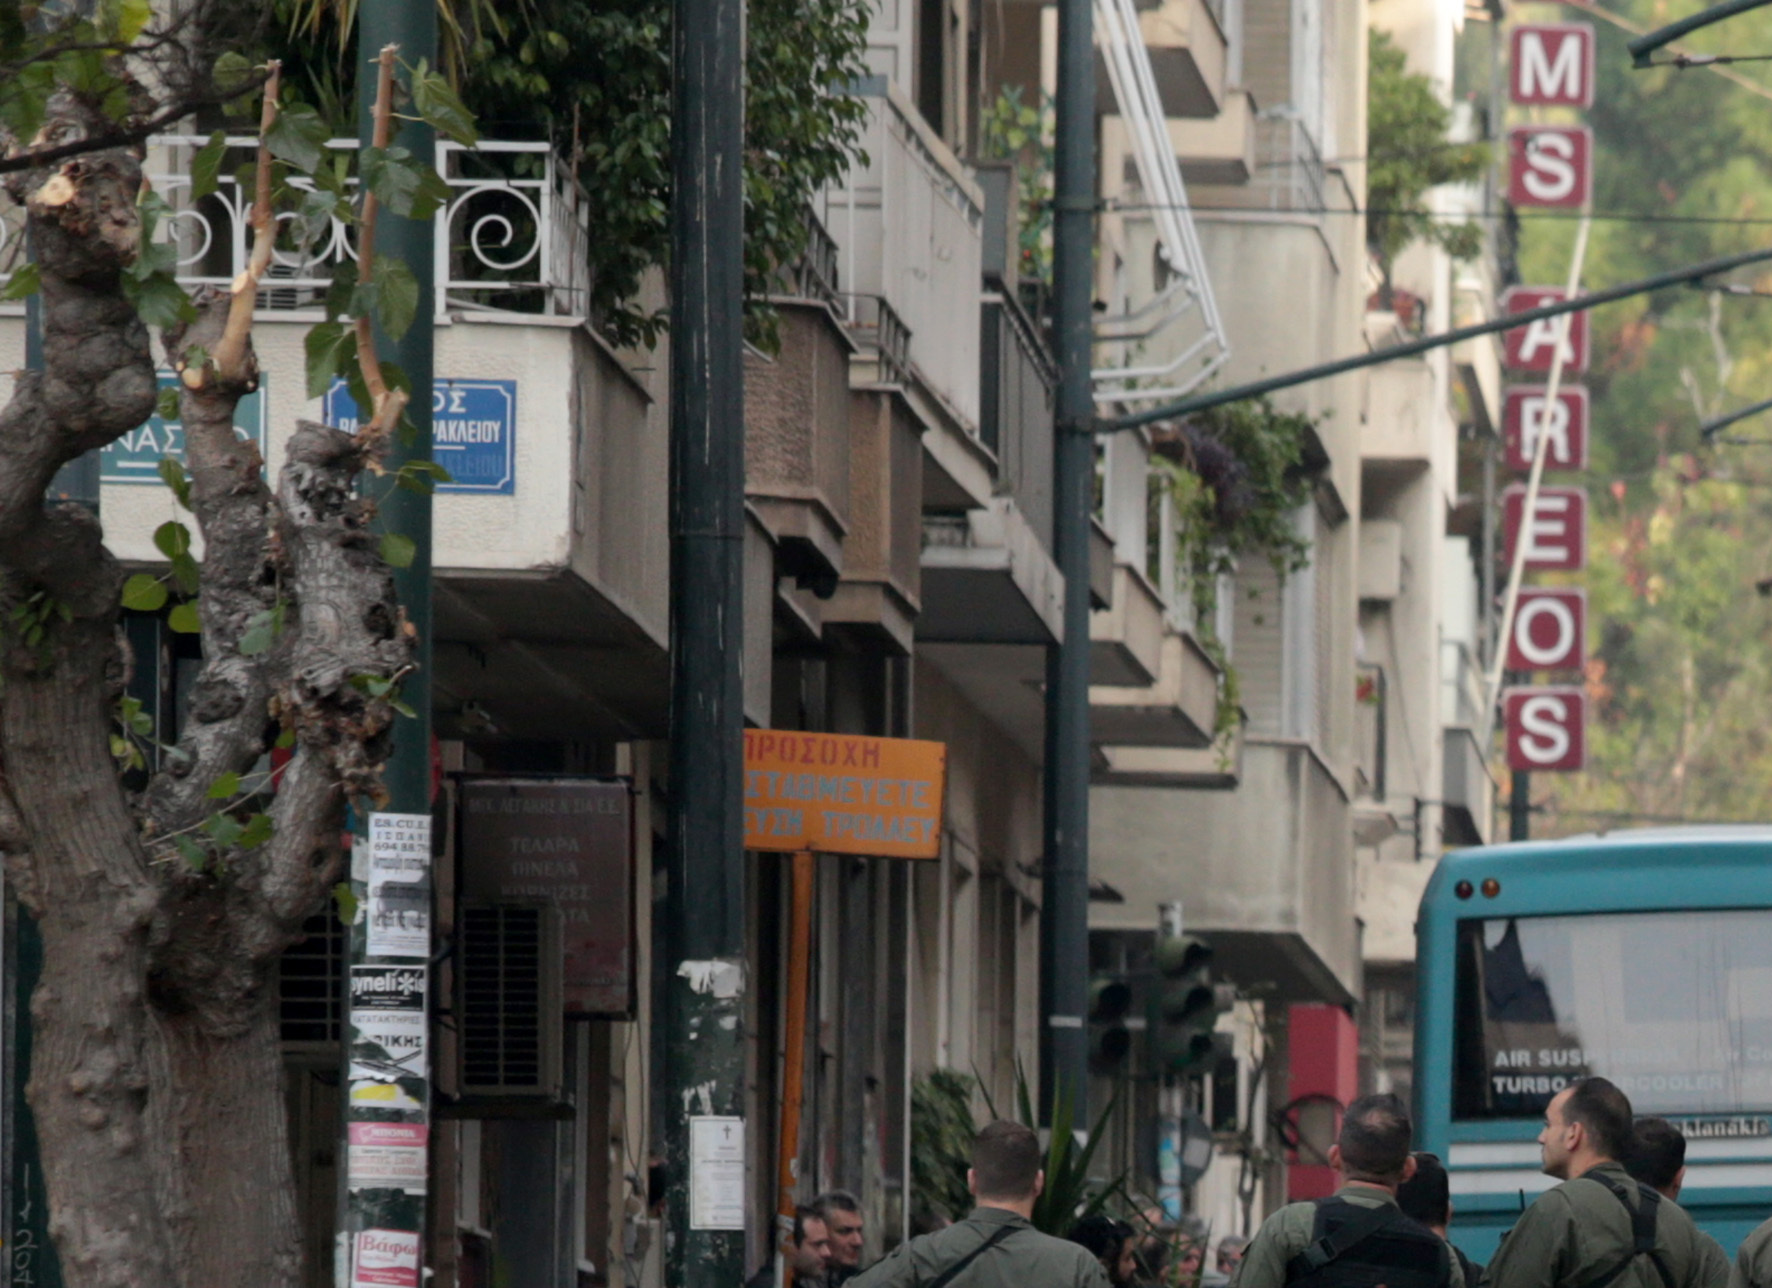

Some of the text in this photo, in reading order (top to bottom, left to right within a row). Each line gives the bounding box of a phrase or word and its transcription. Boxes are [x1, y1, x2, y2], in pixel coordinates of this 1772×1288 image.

[433, 419, 501, 443] ΡΑΚΛΕΙΟΥ
[1495, 1050, 1531, 1067] AIR
[1493, 1076, 1567, 1094] TURBO
